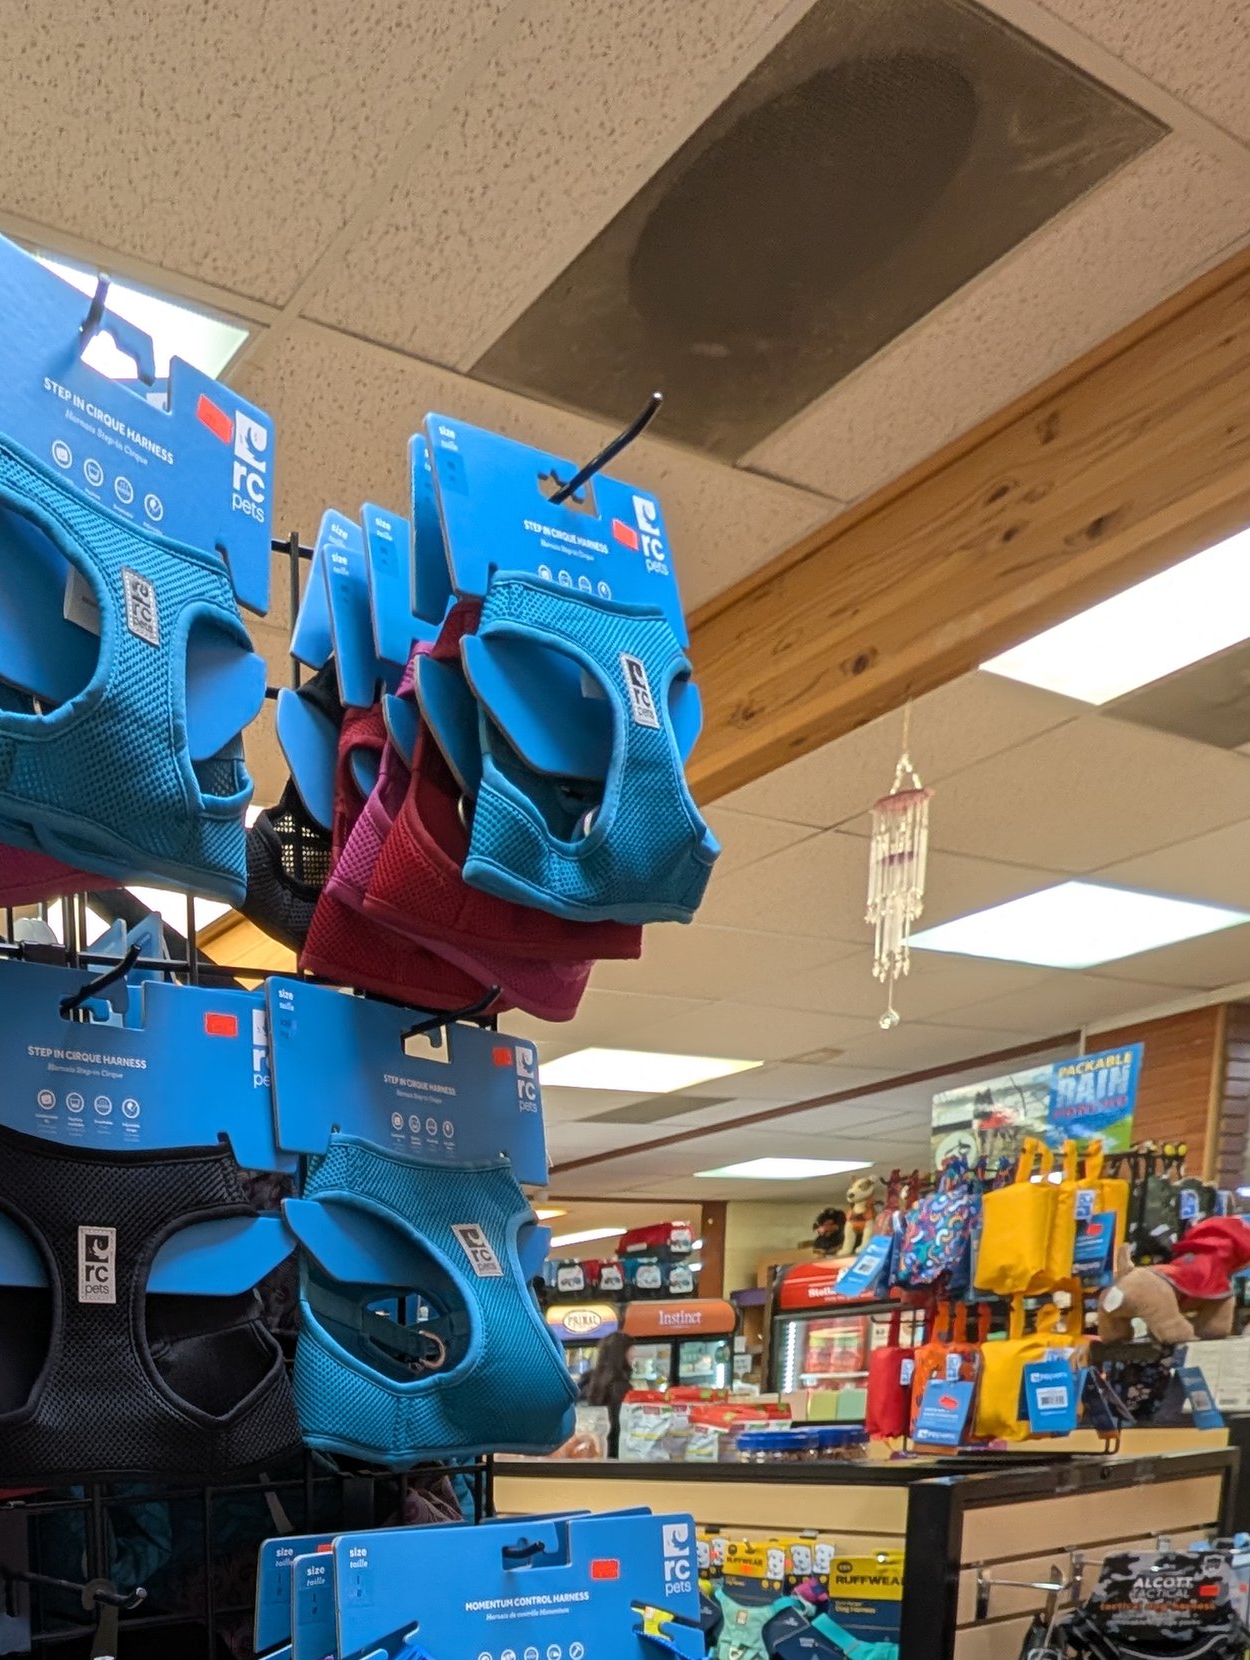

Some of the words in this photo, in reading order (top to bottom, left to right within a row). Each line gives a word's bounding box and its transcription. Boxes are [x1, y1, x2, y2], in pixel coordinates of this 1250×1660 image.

[44, 377, 72, 400] STEP
[73, 394, 86, 411] IN
[86, 403, 126, 435] CIRQUE
[127, 427, 175, 465] HARNESS
[233, 460, 265, 503] rc
[232, 494, 265, 523] pets
[524, 520, 542, 533] STEP
[576, 535, 609, 554] HARNESS
[641, 534, 665, 561] rc
[28, 1045, 53, 1058] STEP
[54, 1049, 65, 1060] IN
[66, 1050, 102, 1064] CIRQUE
[103, 1055, 147, 1069] HARNESS
[383, 1074, 398, 1084] STEP
[429, 1084, 456, 1096] HARNESS
[517, 1079, 536, 1101] rc
[471, 1249, 492, 1262] rc
[85, 1265, 109, 1283] rc
[85, 1285, 110, 1296] pets
[658, 1310, 702, 1326] Instinct
[276, 1547, 293, 1557] size
[350, 1547, 367, 1557] size
[307, 1566, 325, 1576] size
[664, 1559, 691, 1581] rc
[665, 1580, 692, 1597] pets
[835, 1575, 902, 1587] RUFFWEA
[1133, 1576, 1193, 1588] ALCOTT
[465, 1599, 513, 1611] MOMENTUM
[514, 1595, 552, 1607] CONTROL
[553, 1591, 590, 1603] HARNESS
